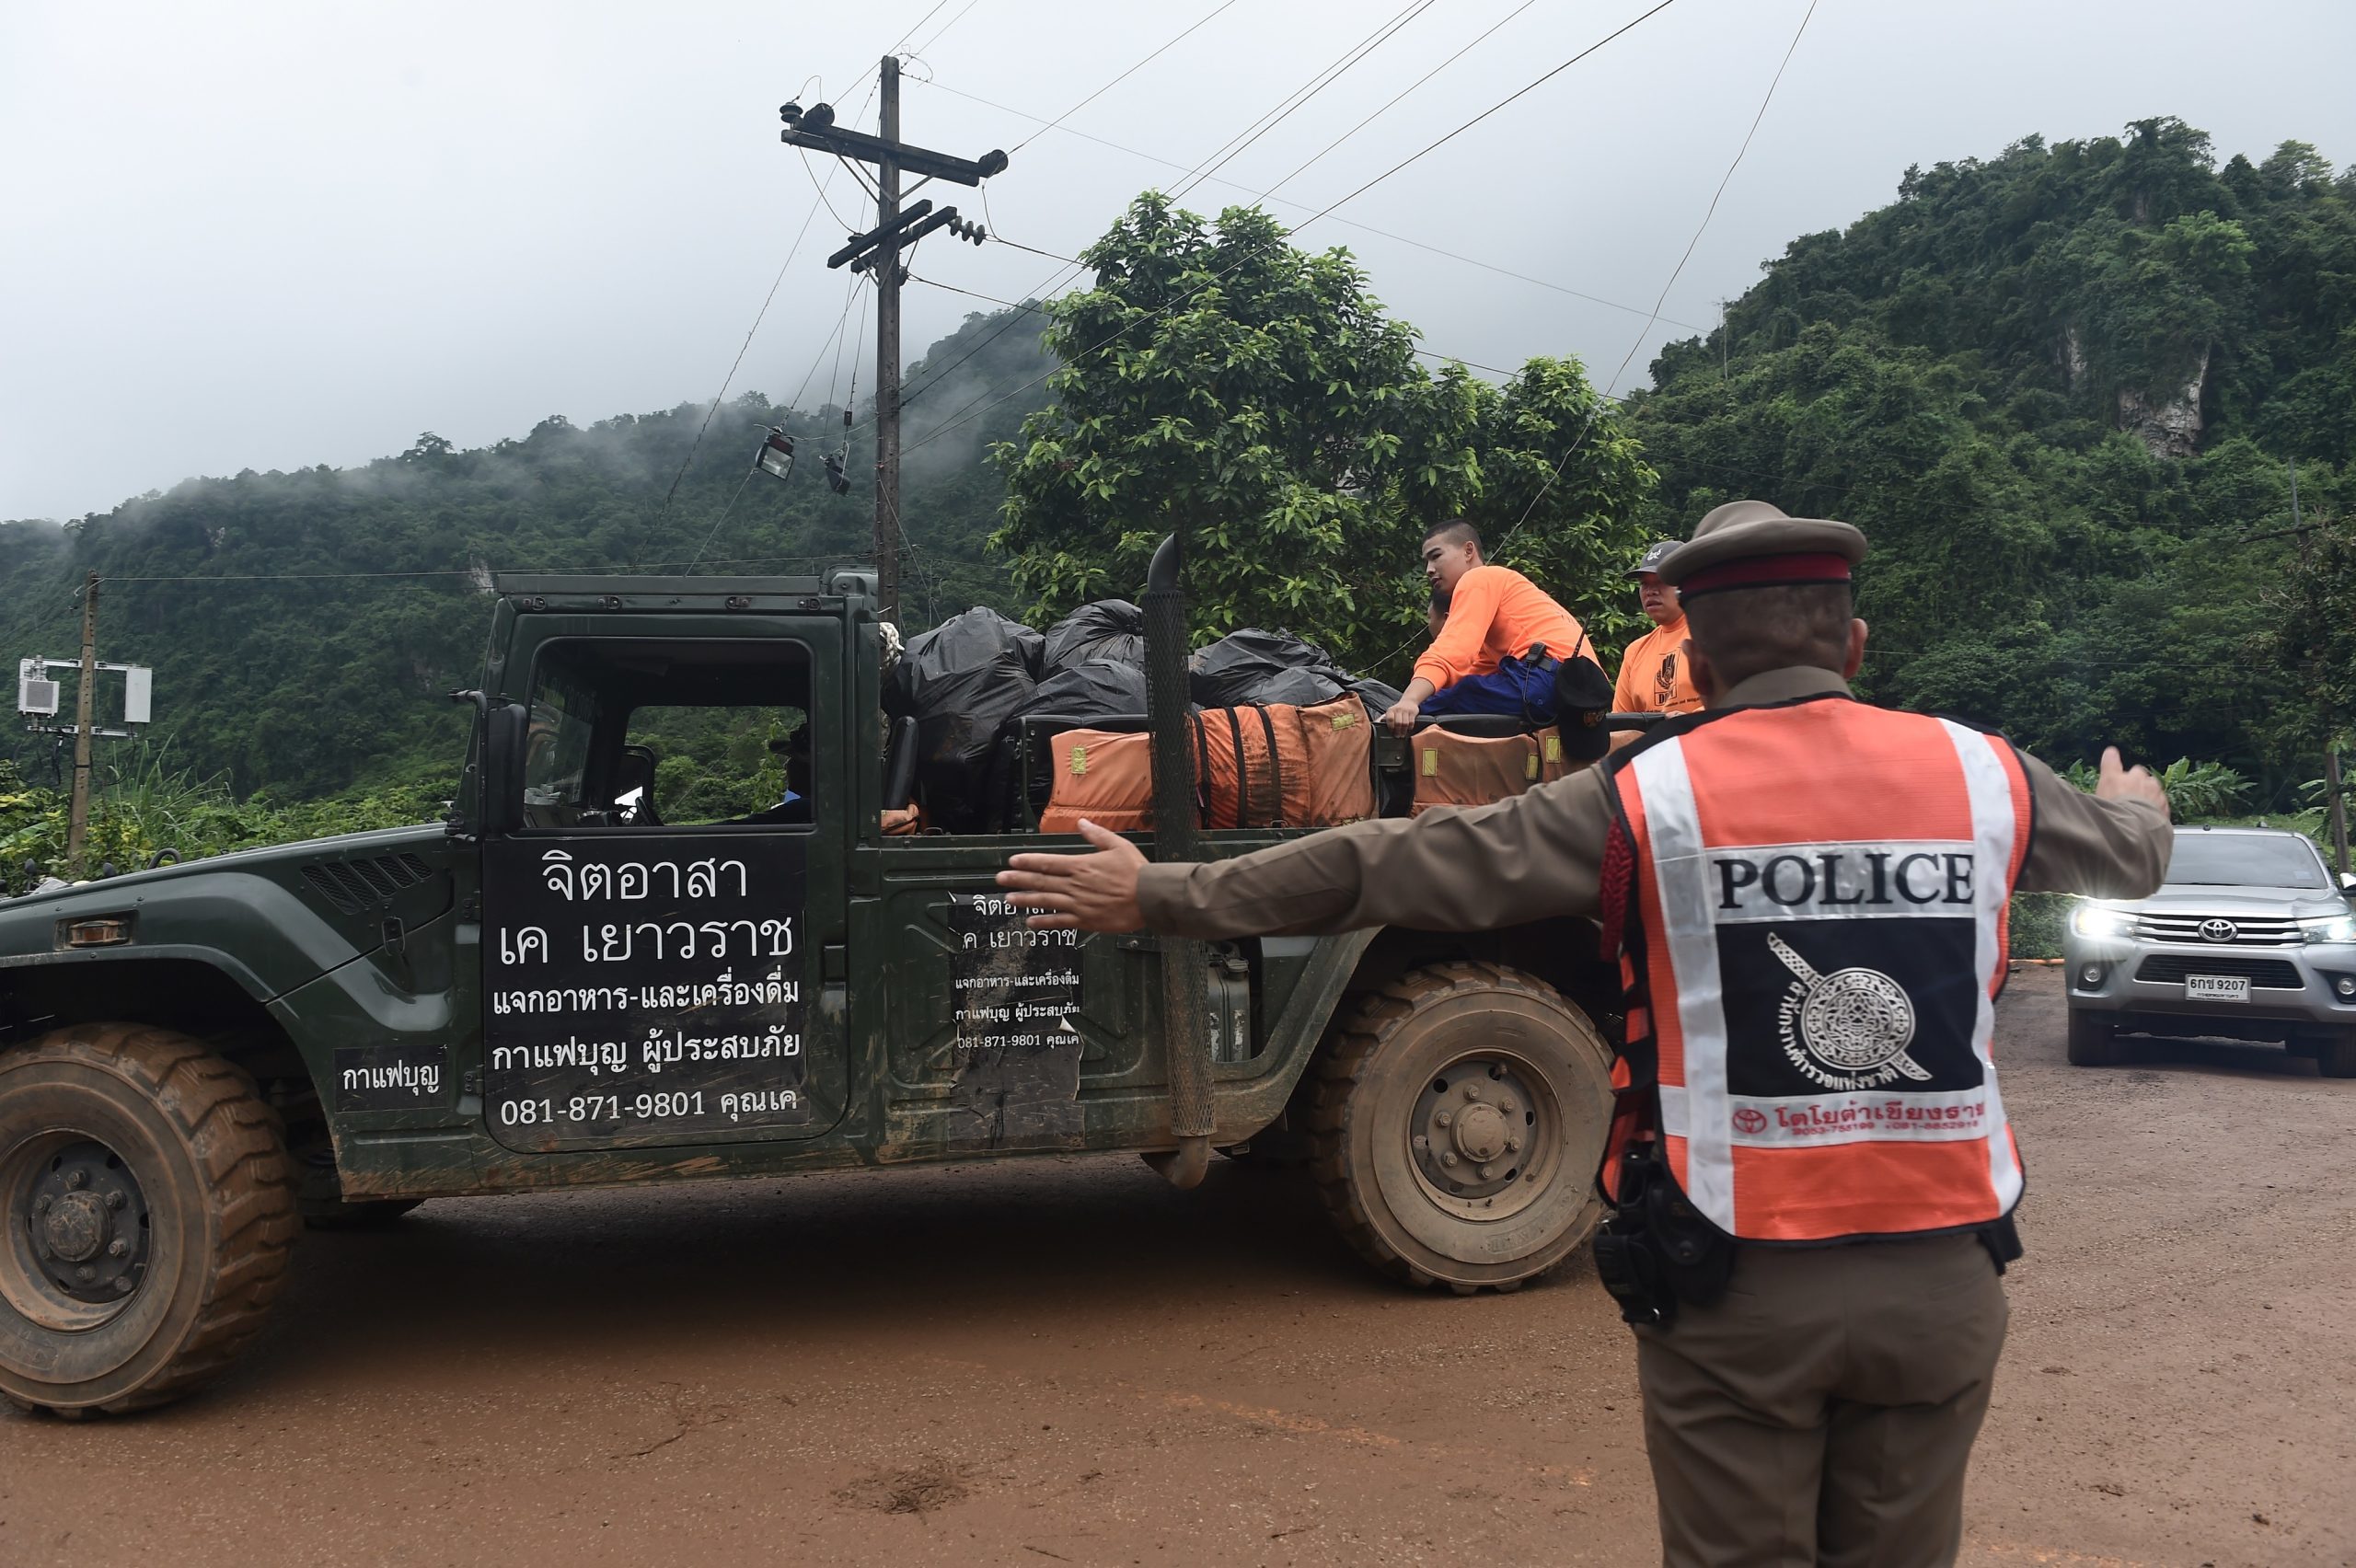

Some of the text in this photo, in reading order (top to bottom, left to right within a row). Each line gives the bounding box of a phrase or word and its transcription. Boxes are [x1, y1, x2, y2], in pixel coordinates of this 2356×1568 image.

[541, 848, 746, 901] จิตอาสา
[1714, 852, 1976, 909] POLICE
[500, 917, 793, 964] เค เยาวราช
[989, 928, 1079, 949] เยาวราช
[493, 966, 799, 1015] แจกอาหาร-และเครื่องดื่ม
[2217, 980, 2246, 991] 9207
[955, 1007, 1010, 1023] กาแฟบุญ
[491, 1024, 801, 1076] กาแฟบุญ ผู้ประสบภัย
[957, 1034, 1080, 1050] 081-871-9801 คุณเค
[342, 1059, 440, 1096] กาแฟบุญ
[500, 1089, 797, 1125] 081-871-9801 คุณเค
